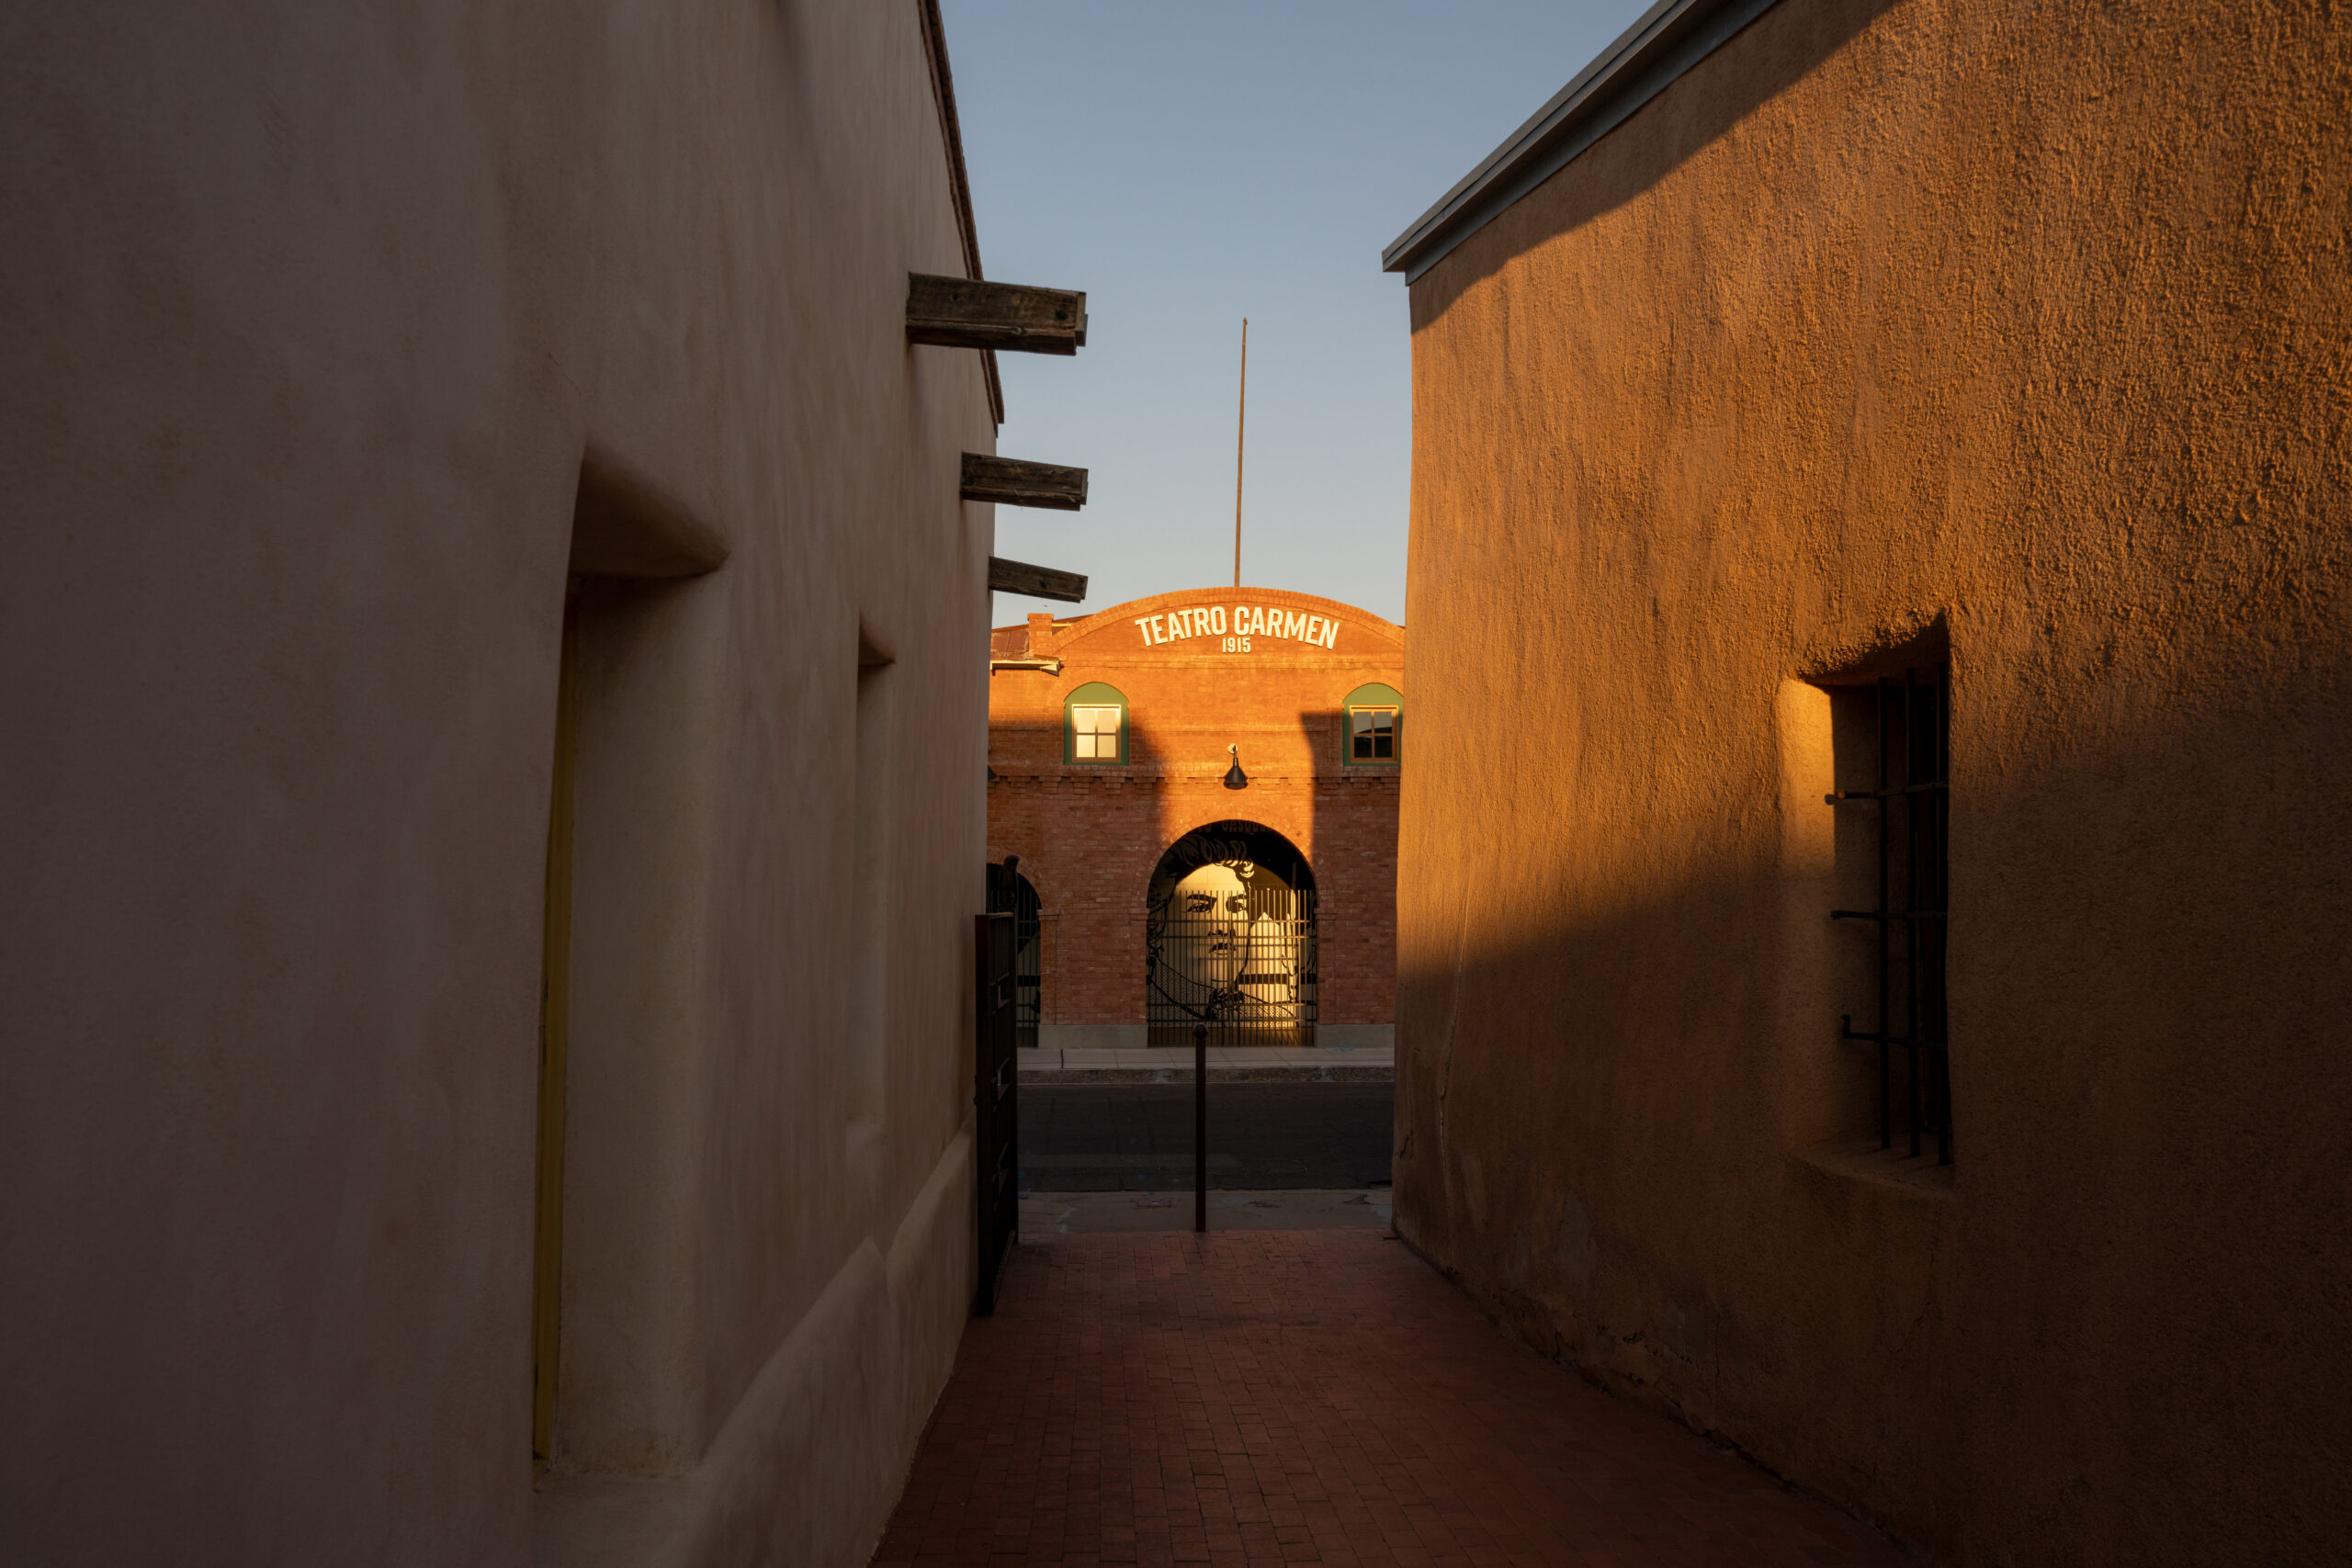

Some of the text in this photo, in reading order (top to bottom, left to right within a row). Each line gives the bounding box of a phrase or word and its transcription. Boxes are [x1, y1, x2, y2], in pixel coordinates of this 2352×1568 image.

[1135, 605, 1340, 649] TEATRO CARMEN
[1222, 637, 1251, 653] 1915
